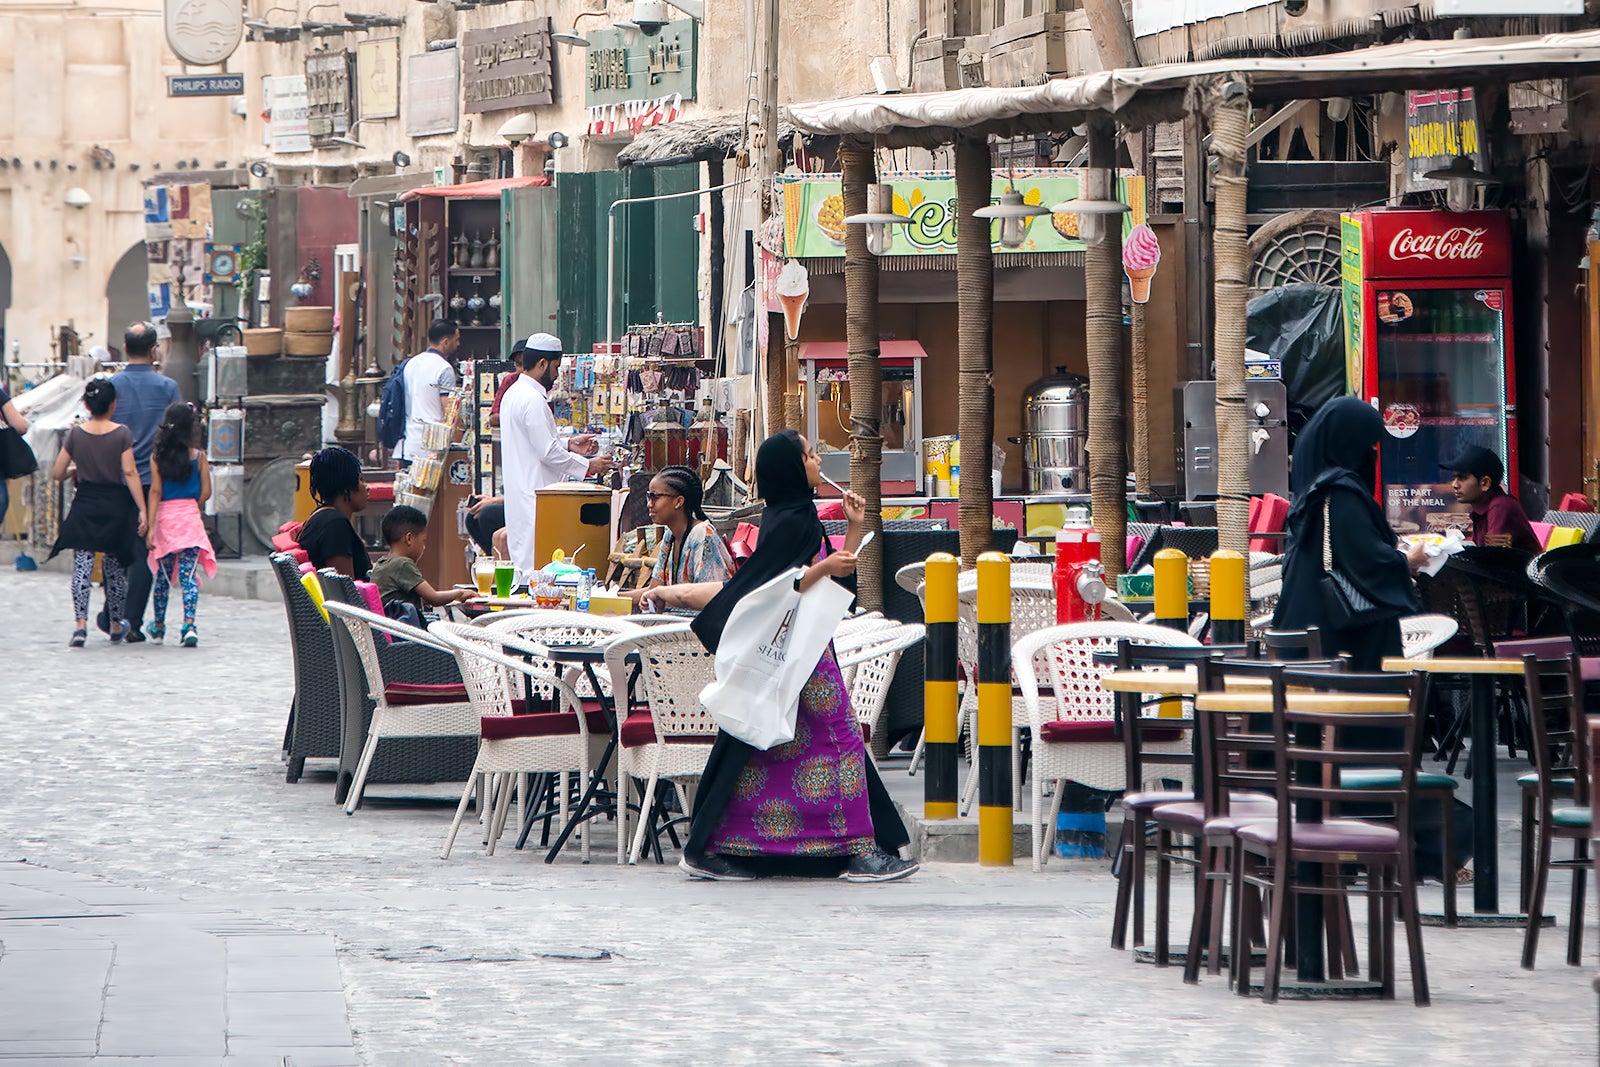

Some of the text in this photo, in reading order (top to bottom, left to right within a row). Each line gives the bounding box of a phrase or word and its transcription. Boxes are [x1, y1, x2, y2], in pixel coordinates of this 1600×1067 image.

[173, 79, 241, 93] PHILIPS RADIO
[1389, 227, 1488, 261] Coca-Cola
[1388, 488, 1432, 497] BEST PART
[1421, 498, 1445, 506] MEAL
